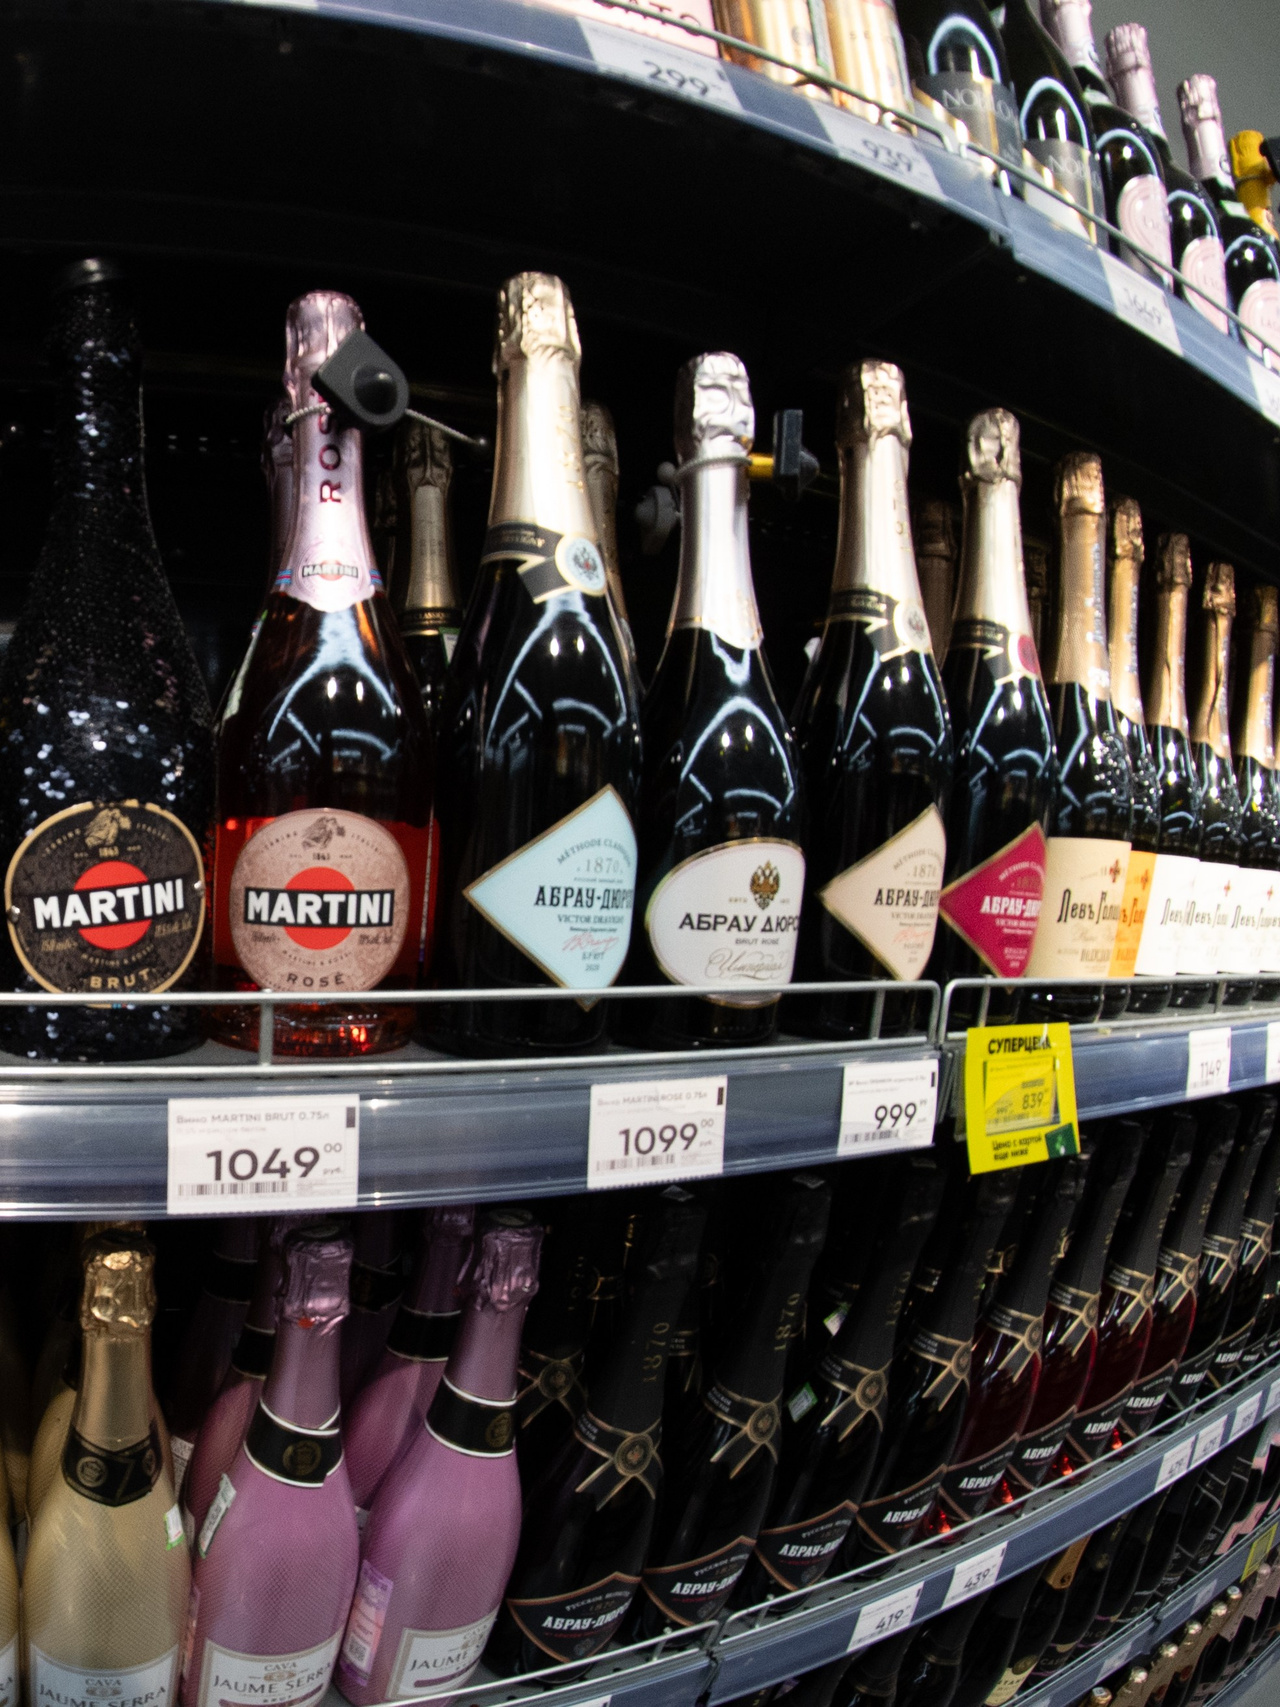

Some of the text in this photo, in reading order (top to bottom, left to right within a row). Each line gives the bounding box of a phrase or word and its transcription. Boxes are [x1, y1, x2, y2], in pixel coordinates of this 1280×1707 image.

[642, 59, 710, 97] 299
[32, 878, 185, 930] MARTINI
[246, 889, 393, 925] MARTINI
[678, 912, 758, 933] АБРАУ
[89, 967, 152, 989] BRUT
[1022, 1092, 1044, 1109] 839
[211, 1113, 261, 1124] MARTINI
[265, 1112, 295, 1121] BRUT
[874, 1102, 918, 1131] 999
[619, 1122, 698, 1156] 1099
[206, 1142, 343, 1181] 1049 00
[963, 1567, 991, 1589] 439
[875, 1609, 904, 1631] 419
[213, 1675, 279, 1695] JAUME
